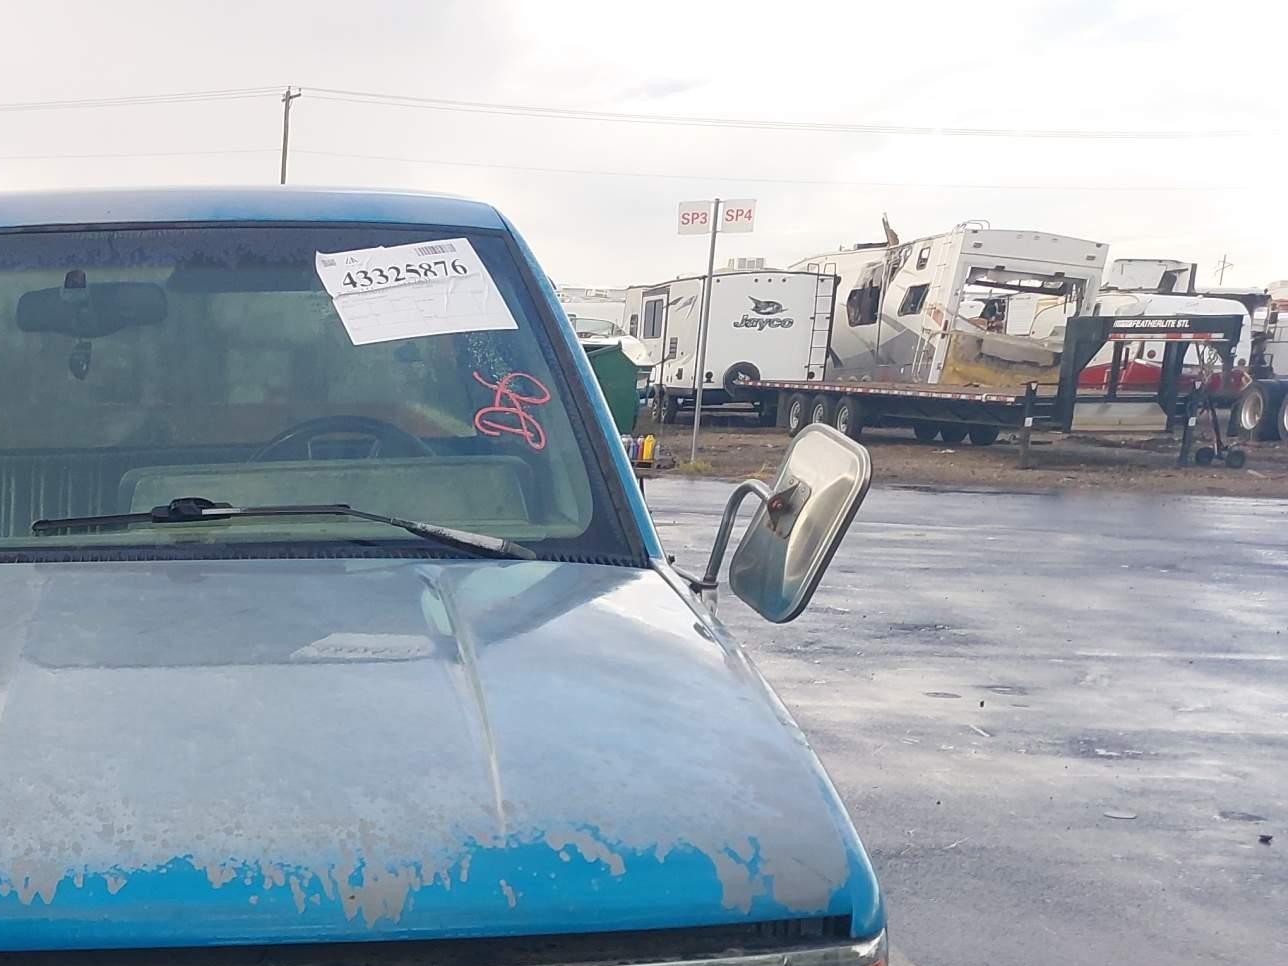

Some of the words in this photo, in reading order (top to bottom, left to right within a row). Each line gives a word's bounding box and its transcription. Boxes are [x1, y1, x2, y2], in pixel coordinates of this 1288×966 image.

[681, 212, 708, 225] SP3
[725, 209, 753, 222] SP4
[342, 258, 468, 288] 43325876
[733, 314, 794, 331] Jayco
